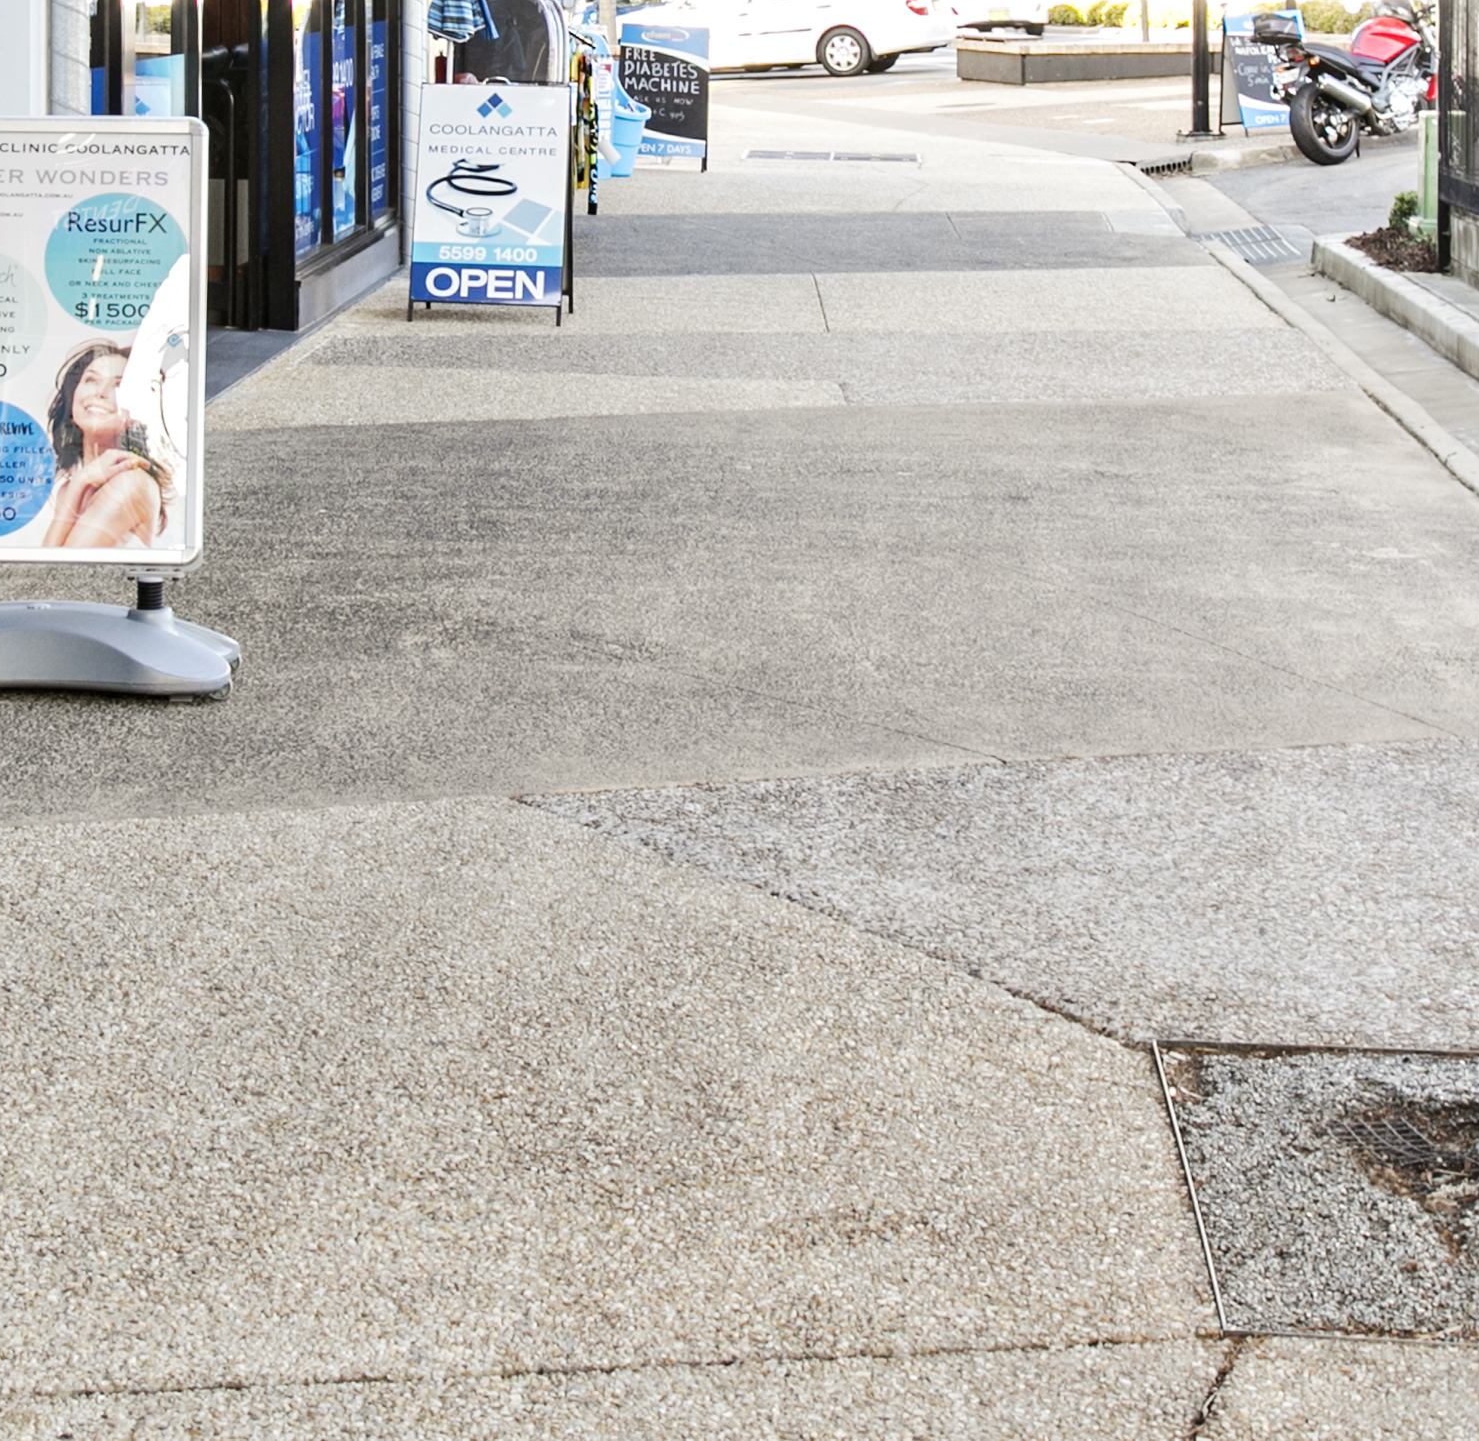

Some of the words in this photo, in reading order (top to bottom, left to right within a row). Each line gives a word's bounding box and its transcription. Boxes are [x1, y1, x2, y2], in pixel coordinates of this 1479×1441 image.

[625, 47, 656, 61] FREE
[624, 60, 698, 79] DIABETES
[624, 78, 700, 95] MACHINE
[1255, 114, 1279, 124] OPEN
[1280, 114, 1286, 123] 7
[429, 123, 558, 138] COOLANGATTA
[0, 143, 58, 154] CLINIC
[65, 143, 191, 156] COOLANGATTA
[428, 145, 493, 156] MEDICAL
[499, 146, 557, 157] CENTRE
[657, 144, 665, 153] 7
[667, 144, 692, 155] DAYS
[35, 169, 169, 187] WONDERS
[68, 212, 167, 234] ResurFX
[439, 245, 487, 261] 5599
[493, 247, 537, 263] 1400
[425, 267, 545, 299] OPEN
[91, 292, 150, 300] TREATMENTS
[14, 445, 52, 455] FILLER
[0, 475, 14, 484] 50
